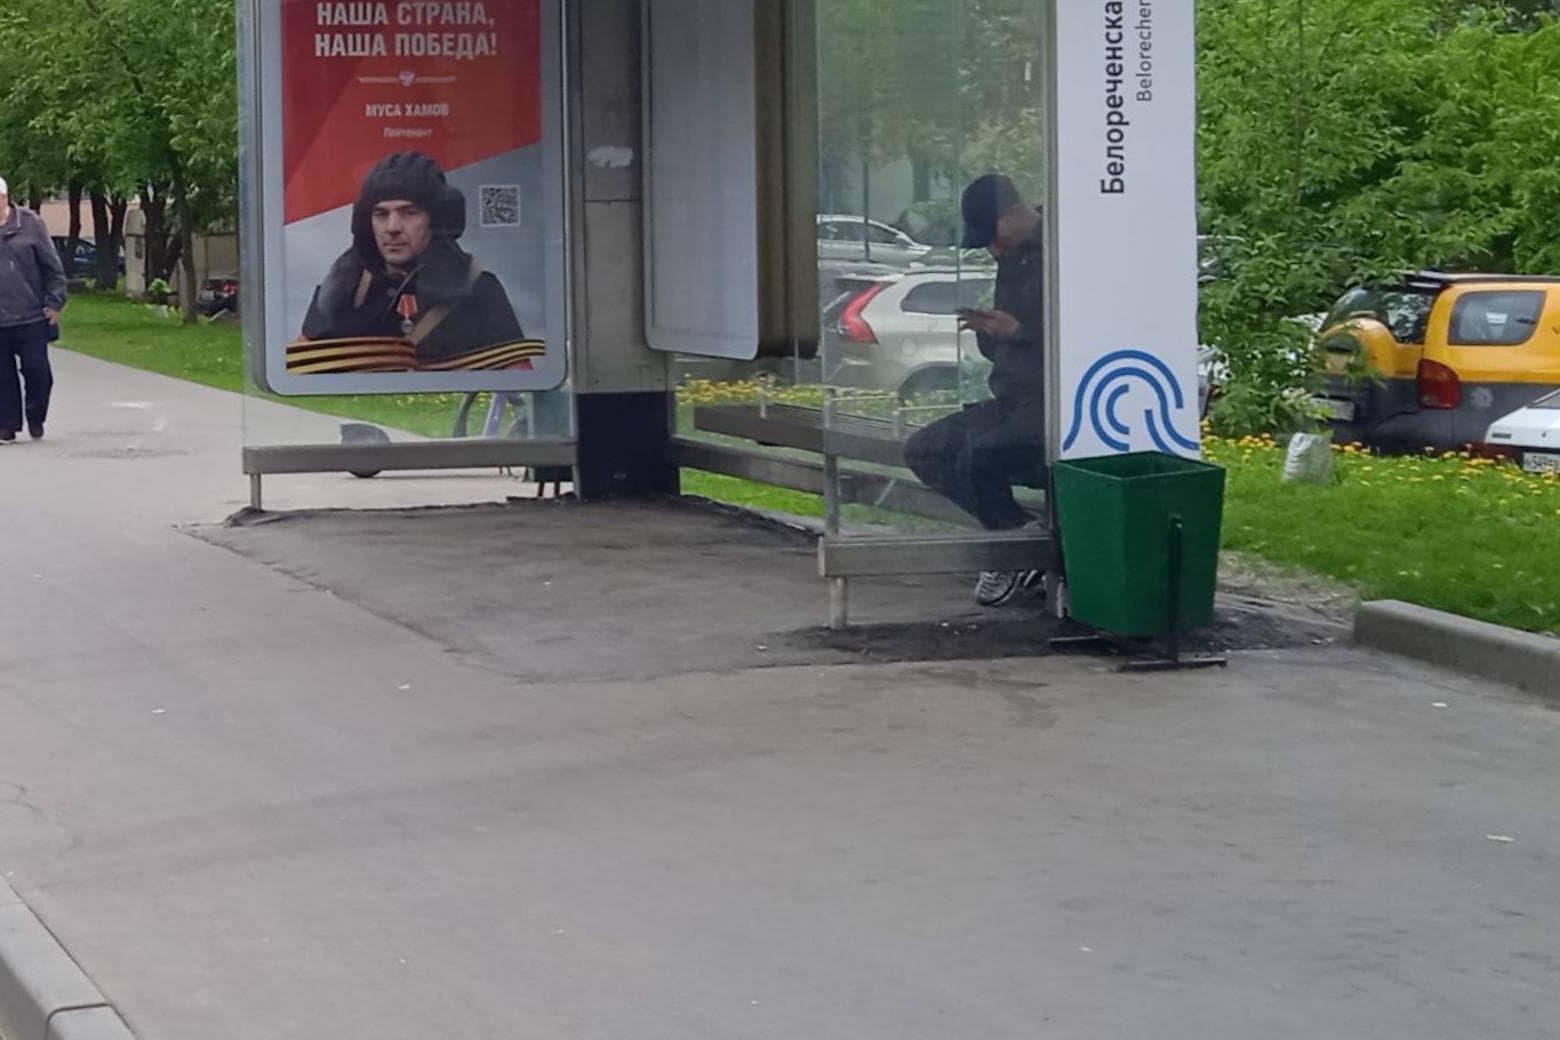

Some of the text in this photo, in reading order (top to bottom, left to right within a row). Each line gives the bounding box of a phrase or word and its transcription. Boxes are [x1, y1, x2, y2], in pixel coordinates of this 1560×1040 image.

[317, 1, 495, 29] НАША СТРАНА,
[315, 32, 497, 59] НАША ПОБЕДА!
[366, 103, 449, 117] МУСА ХАМОВ
